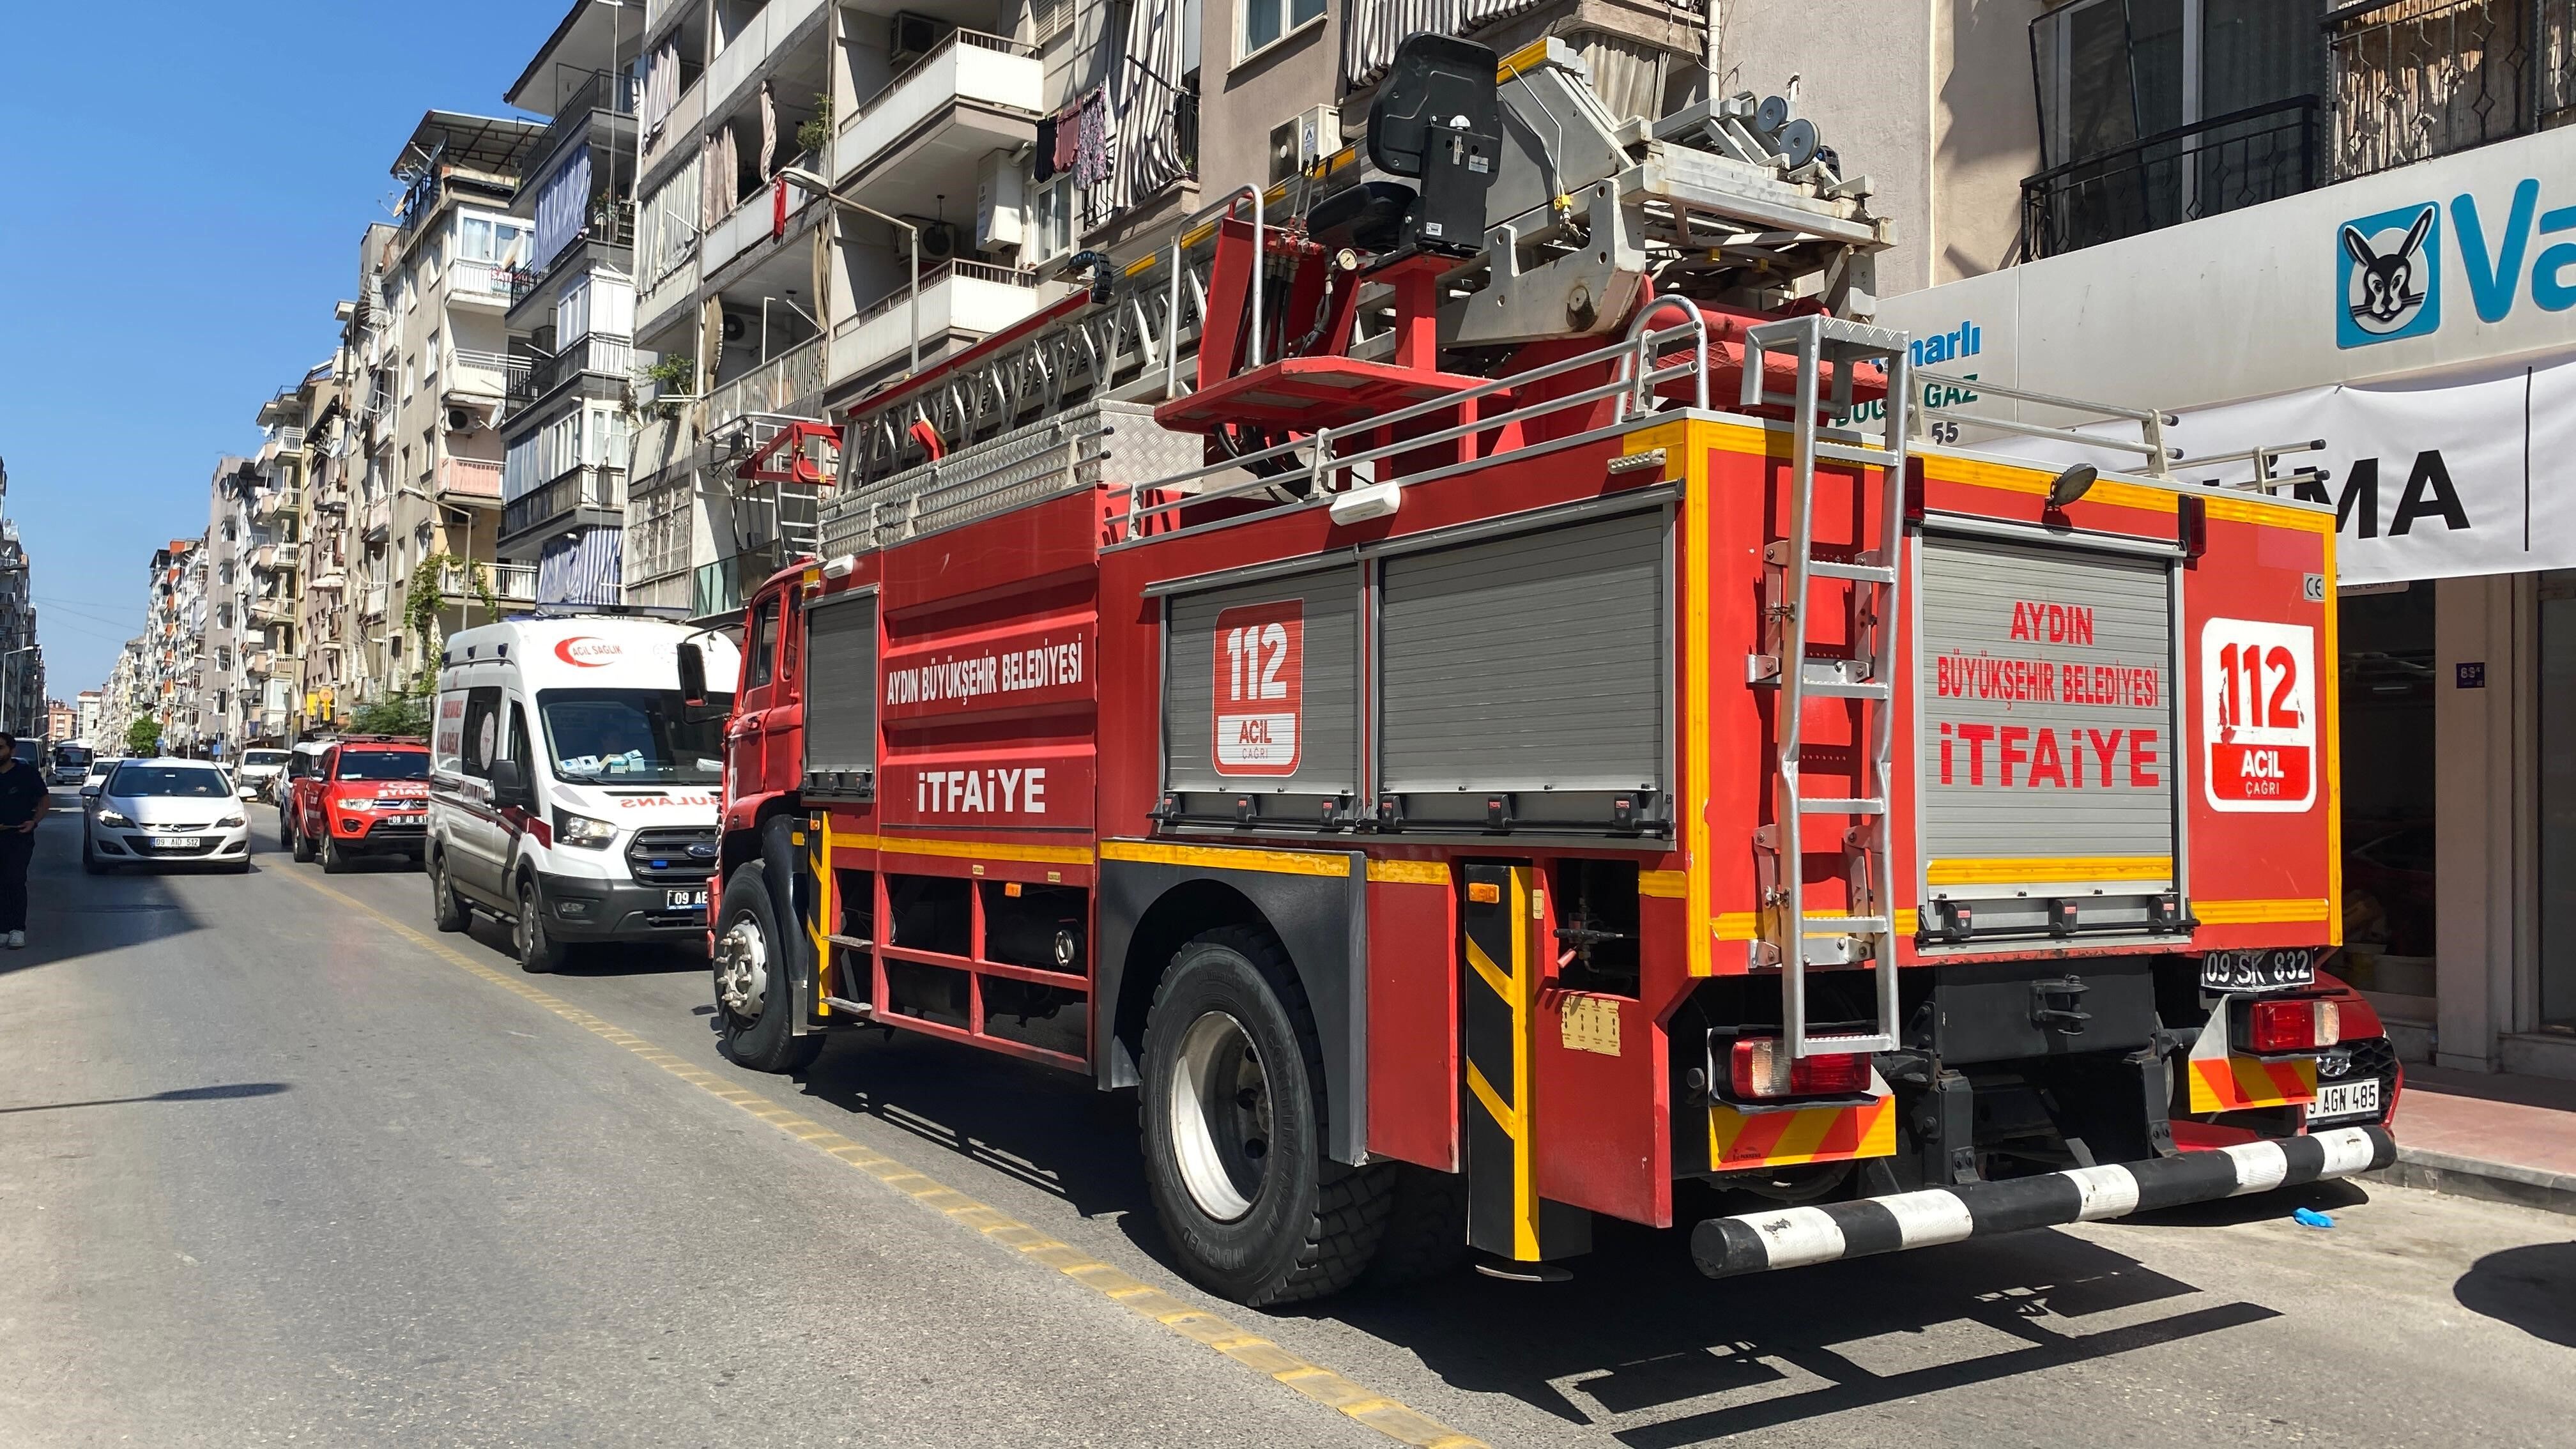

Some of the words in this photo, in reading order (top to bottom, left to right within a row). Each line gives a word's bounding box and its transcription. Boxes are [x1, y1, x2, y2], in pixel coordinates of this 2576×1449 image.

[1924, 373, 1978, 408] GAZ
[2267, 449, 2472, 540] MA
[2009, 601, 2094, 645] AYDIN
[887, 662, 919, 705] AYDIN
[922, 648, 997, 705] BÜYÜKŞEHİR
[1002, 633, 1082, 692] BELEDİYESİ
[1227, 622, 1287, 701] 112
[1938, 648, 2055, 711] BÜYÜKŞEHİR
[2062, 659, 2159, 707] BELEDİYESİ
[2220, 642, 2299, 729] 112
[1242, 746, 1268, 762] ÇAĞRI
[1940, 722, 2159, 788] İTFAİYE
[2241, 749, 2284, 779] ACİL
[918, 768, 1046, 813] İTFAİYE
[2245, 779, 2280, 797] ÇAĞRI
[675, 892, 689, 904] 09
[2206, 953, 2230, 983] 09
[2237, 955, 2266, 985] SK
[2274, 949, 2310, 980] 832
[2323, 1087, 2347, 1114] AGN
[2352, 1084, 2376, 1109] 485
